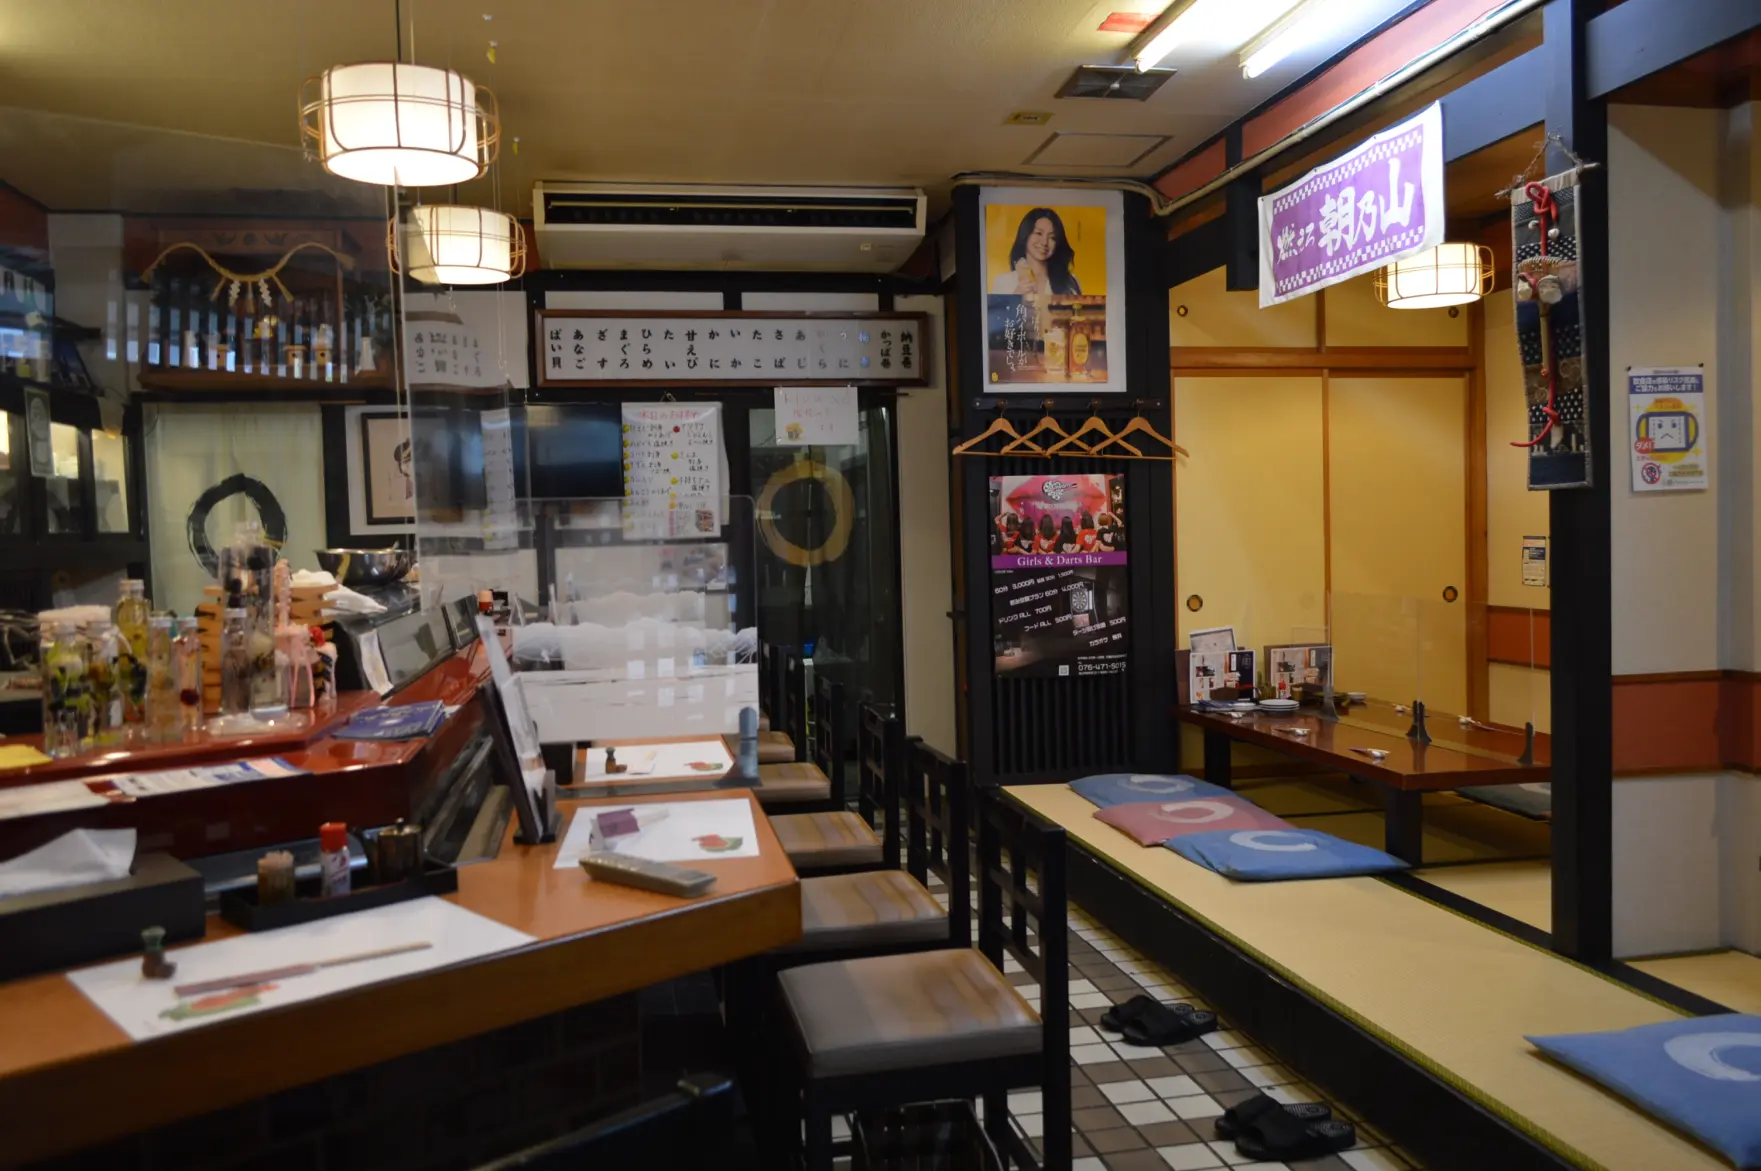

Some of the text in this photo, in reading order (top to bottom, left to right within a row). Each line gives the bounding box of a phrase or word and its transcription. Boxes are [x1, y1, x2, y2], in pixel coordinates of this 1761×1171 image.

[1318, 157, 1415, 256] 朝乃山
[549, 328, 562, 369] ばい貝
[573, 329, 585, 370] あなご
[619, 329, 630, 369] まぐろ
[641, 329, 653, 369] ひらめ
[664, 329, 676, 369] たい
[685, 329, 698, 369] 甘えび
[708, 329, 720, 369] かに
[730, 330, 742, 369] いか
[752, 330, 763, 369] たこ
[774, 329, 785, 369] さば
[796, 330, 808, 369] あじ
[901, 331, 913, 369] 納豆巻
[1017, 554, 1102, 566] Girls & Darts Bar
